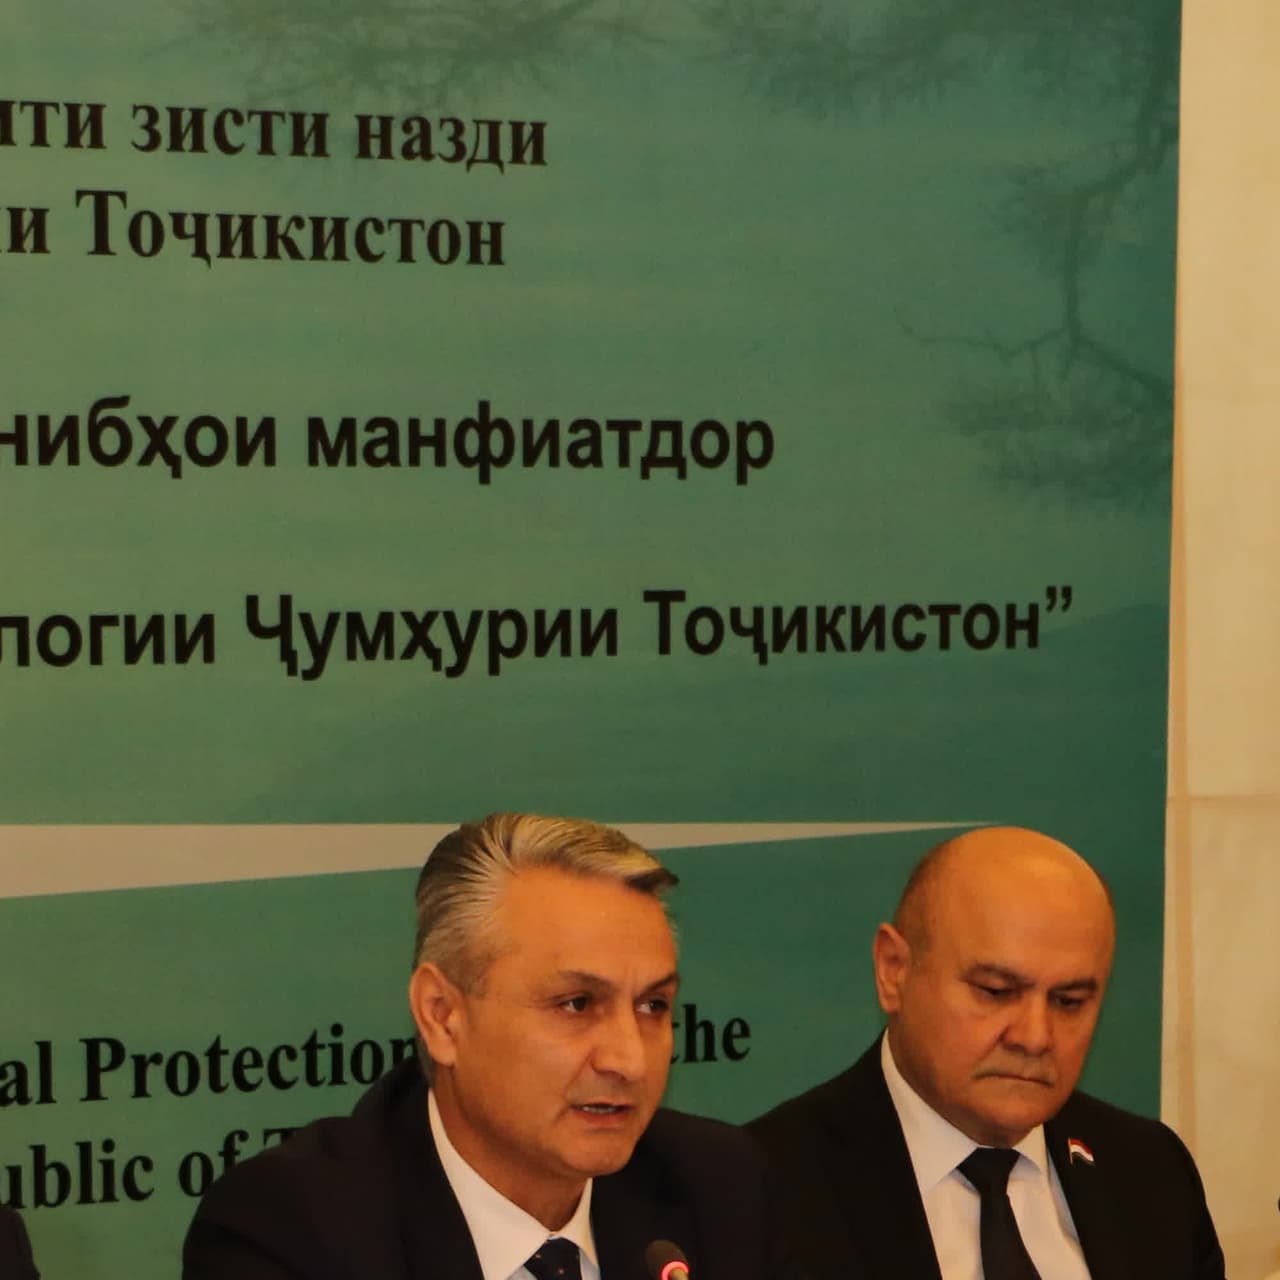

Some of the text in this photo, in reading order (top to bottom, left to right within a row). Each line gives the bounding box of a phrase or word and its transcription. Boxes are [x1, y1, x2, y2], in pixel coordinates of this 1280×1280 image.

[132, 105, 329, 158] зисти
[355, 115, 547, 172] назди
[76, 190, 504, 266] Тоҷикистон
[308, 401, 773, 485] манфиатдор
[246, 595, 617, 680] Ҷумҳурии
